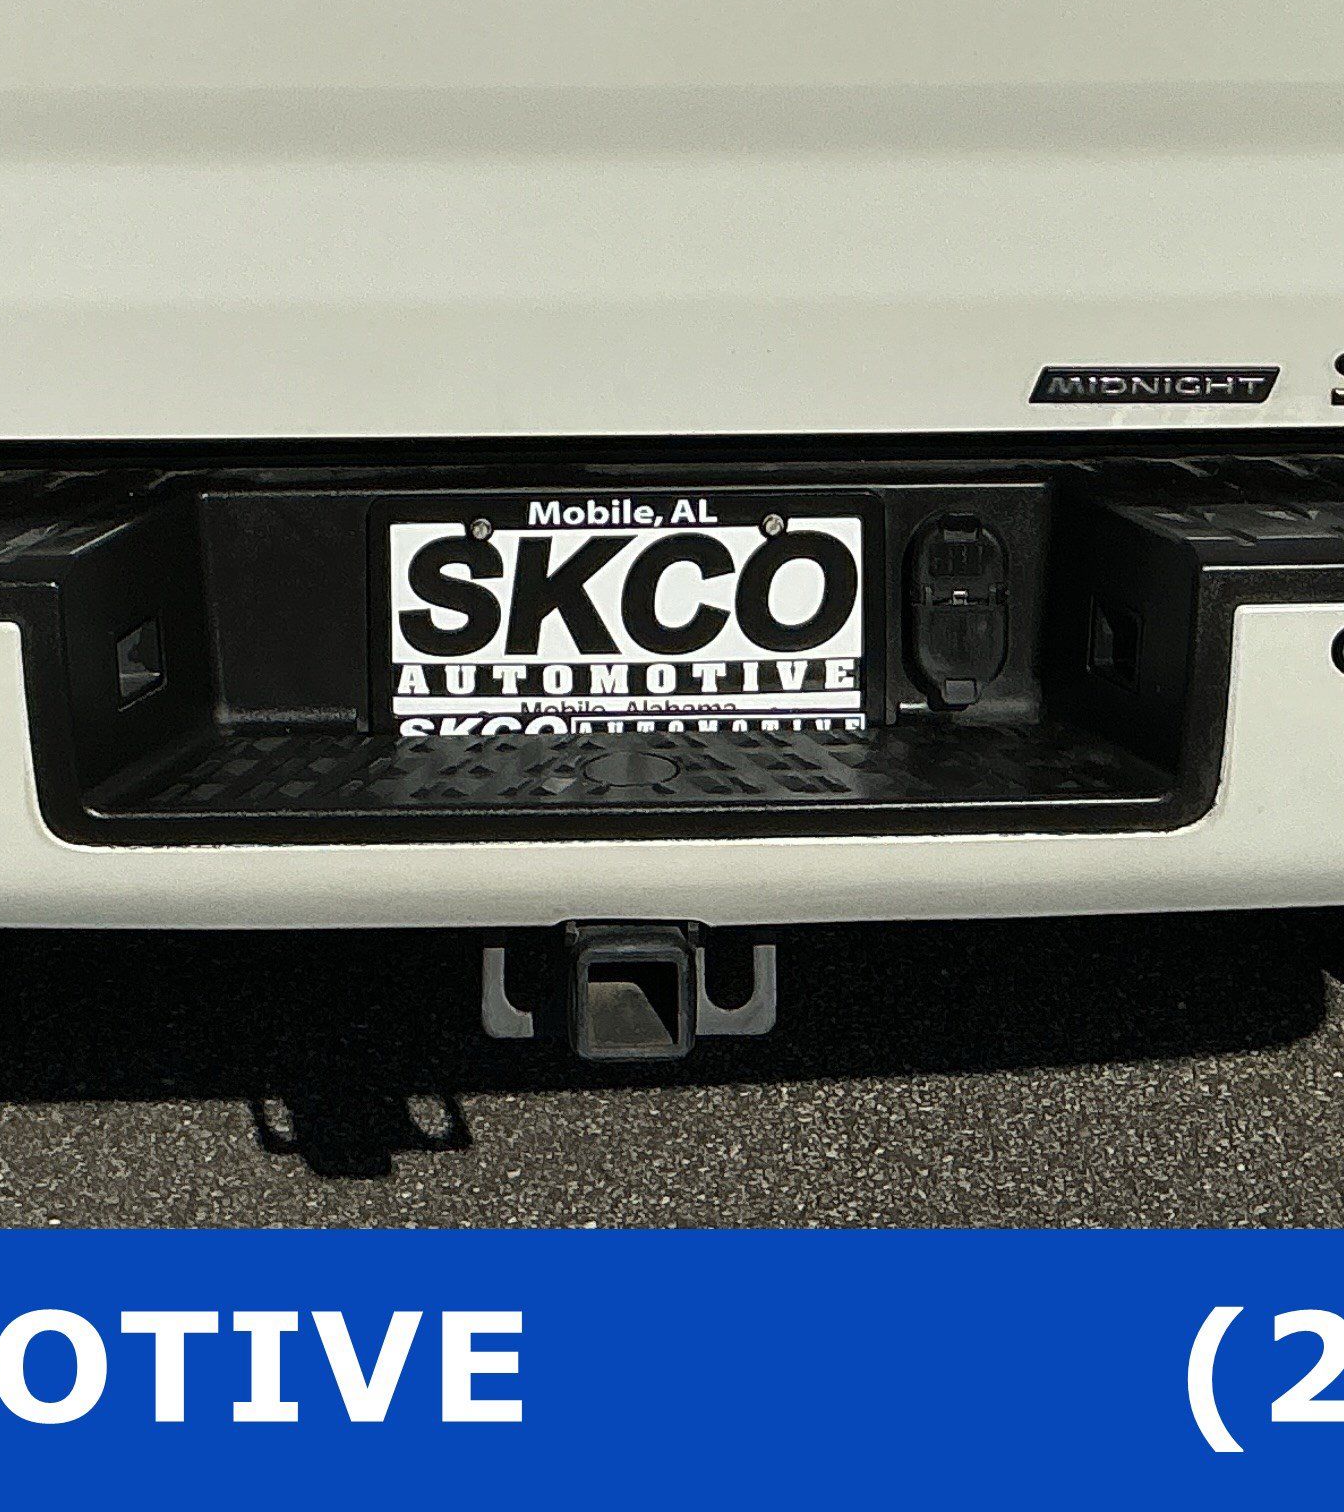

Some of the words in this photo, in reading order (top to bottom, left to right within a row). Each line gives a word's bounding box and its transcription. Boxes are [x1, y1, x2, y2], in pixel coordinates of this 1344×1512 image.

[1047, 376, 1265, 396] MIDNIGHT
[528, 499, 663, 527] Mobile,
[671, 498, 718, 524] AL
[398, 530, 858, 656] SKCO
[397, 659, 855, 695] AUTOMOTIVE
